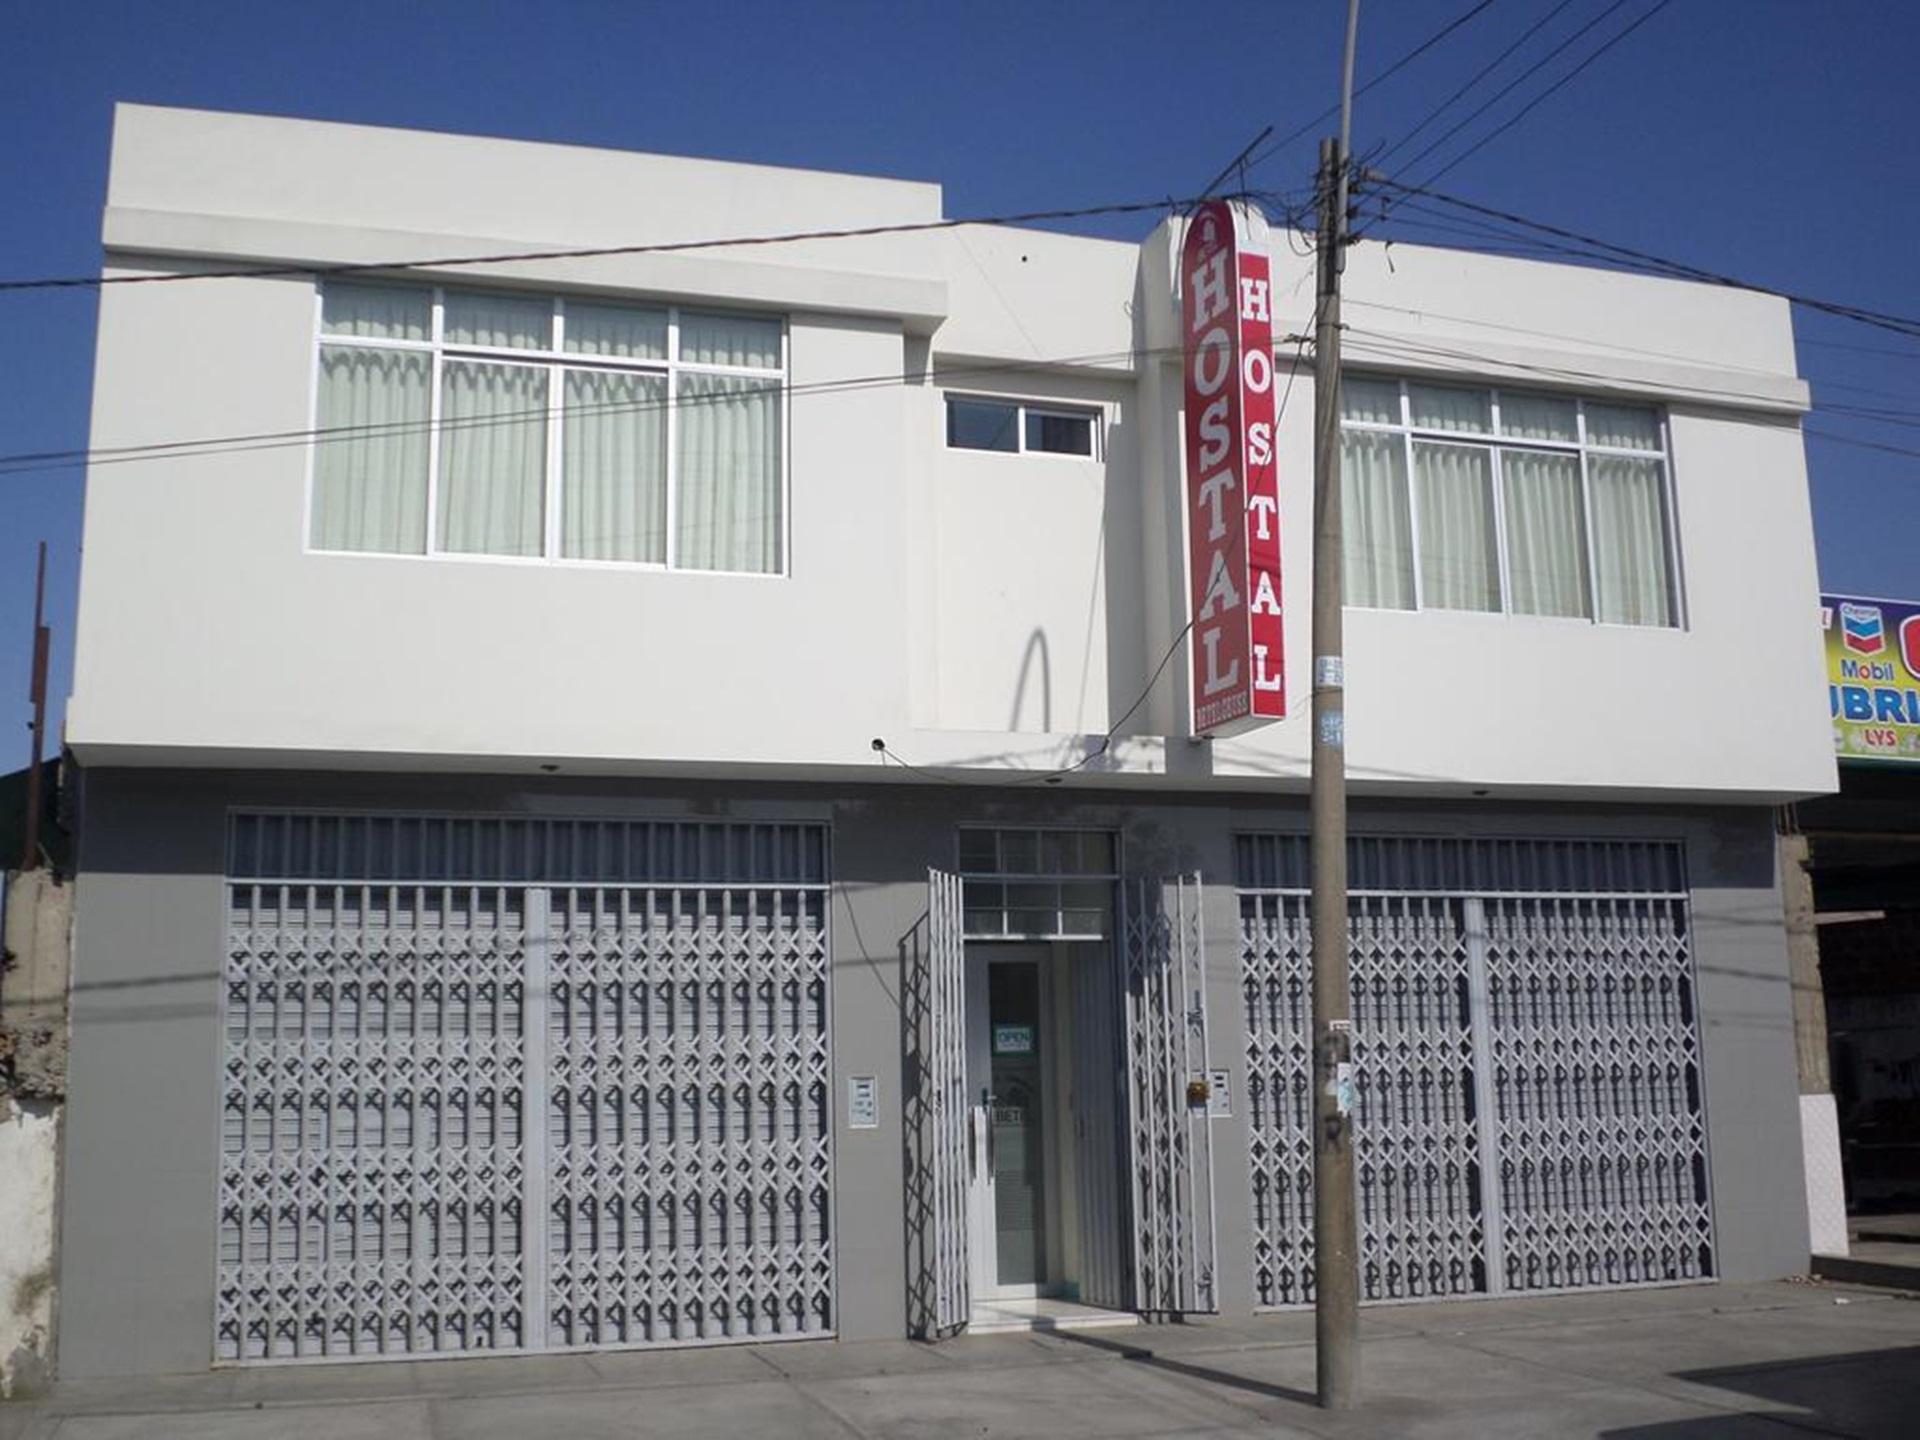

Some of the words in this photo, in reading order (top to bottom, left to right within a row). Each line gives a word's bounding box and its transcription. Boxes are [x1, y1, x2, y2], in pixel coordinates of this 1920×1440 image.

[1191, 249, 1240, 696] HOSTAL
[1240, 277, 1282, 691] HOSTAL
[1841, 659, 1894, 681] Mobil
[1865, 729, 1896, 746] LYS
